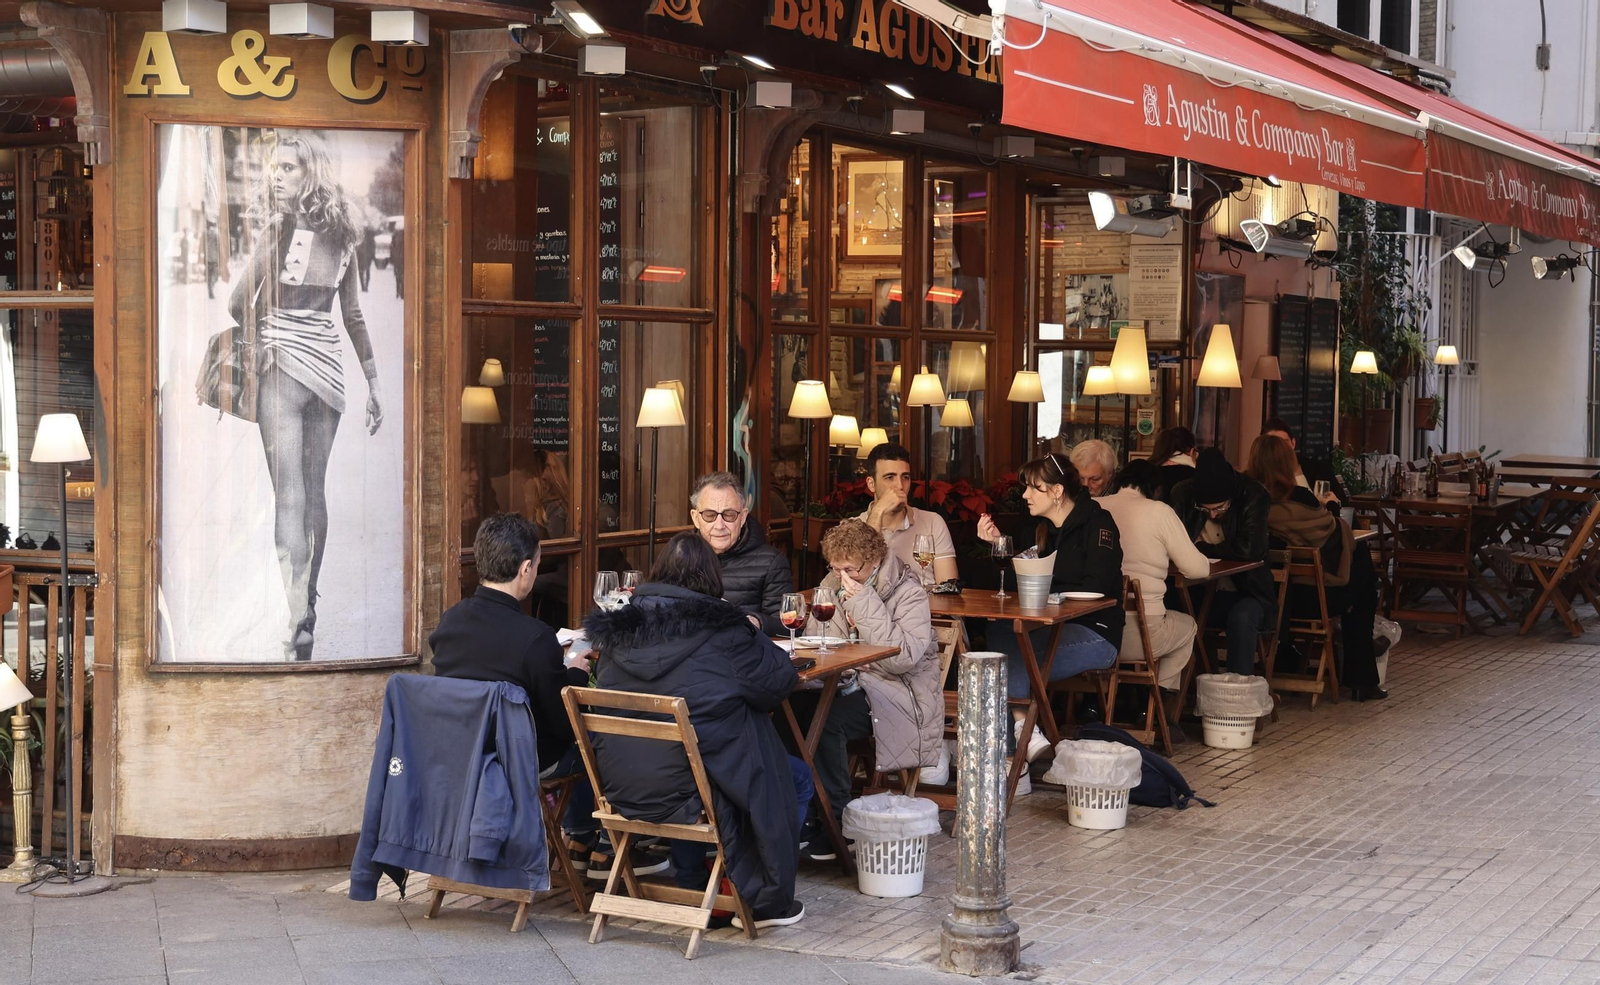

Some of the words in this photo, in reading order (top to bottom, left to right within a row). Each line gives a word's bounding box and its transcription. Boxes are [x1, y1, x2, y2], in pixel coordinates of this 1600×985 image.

[771, 0, 844, 42] Bar
[123, 31, 190, 95] A
[217, 29, 295, 98] &
[1166, 84, 1231, 141] Agustin
[1236, 105, 1251, 147] &
[1252, 109, 1321, 170] Company
[1321, 126, 1344, 168] Bar
